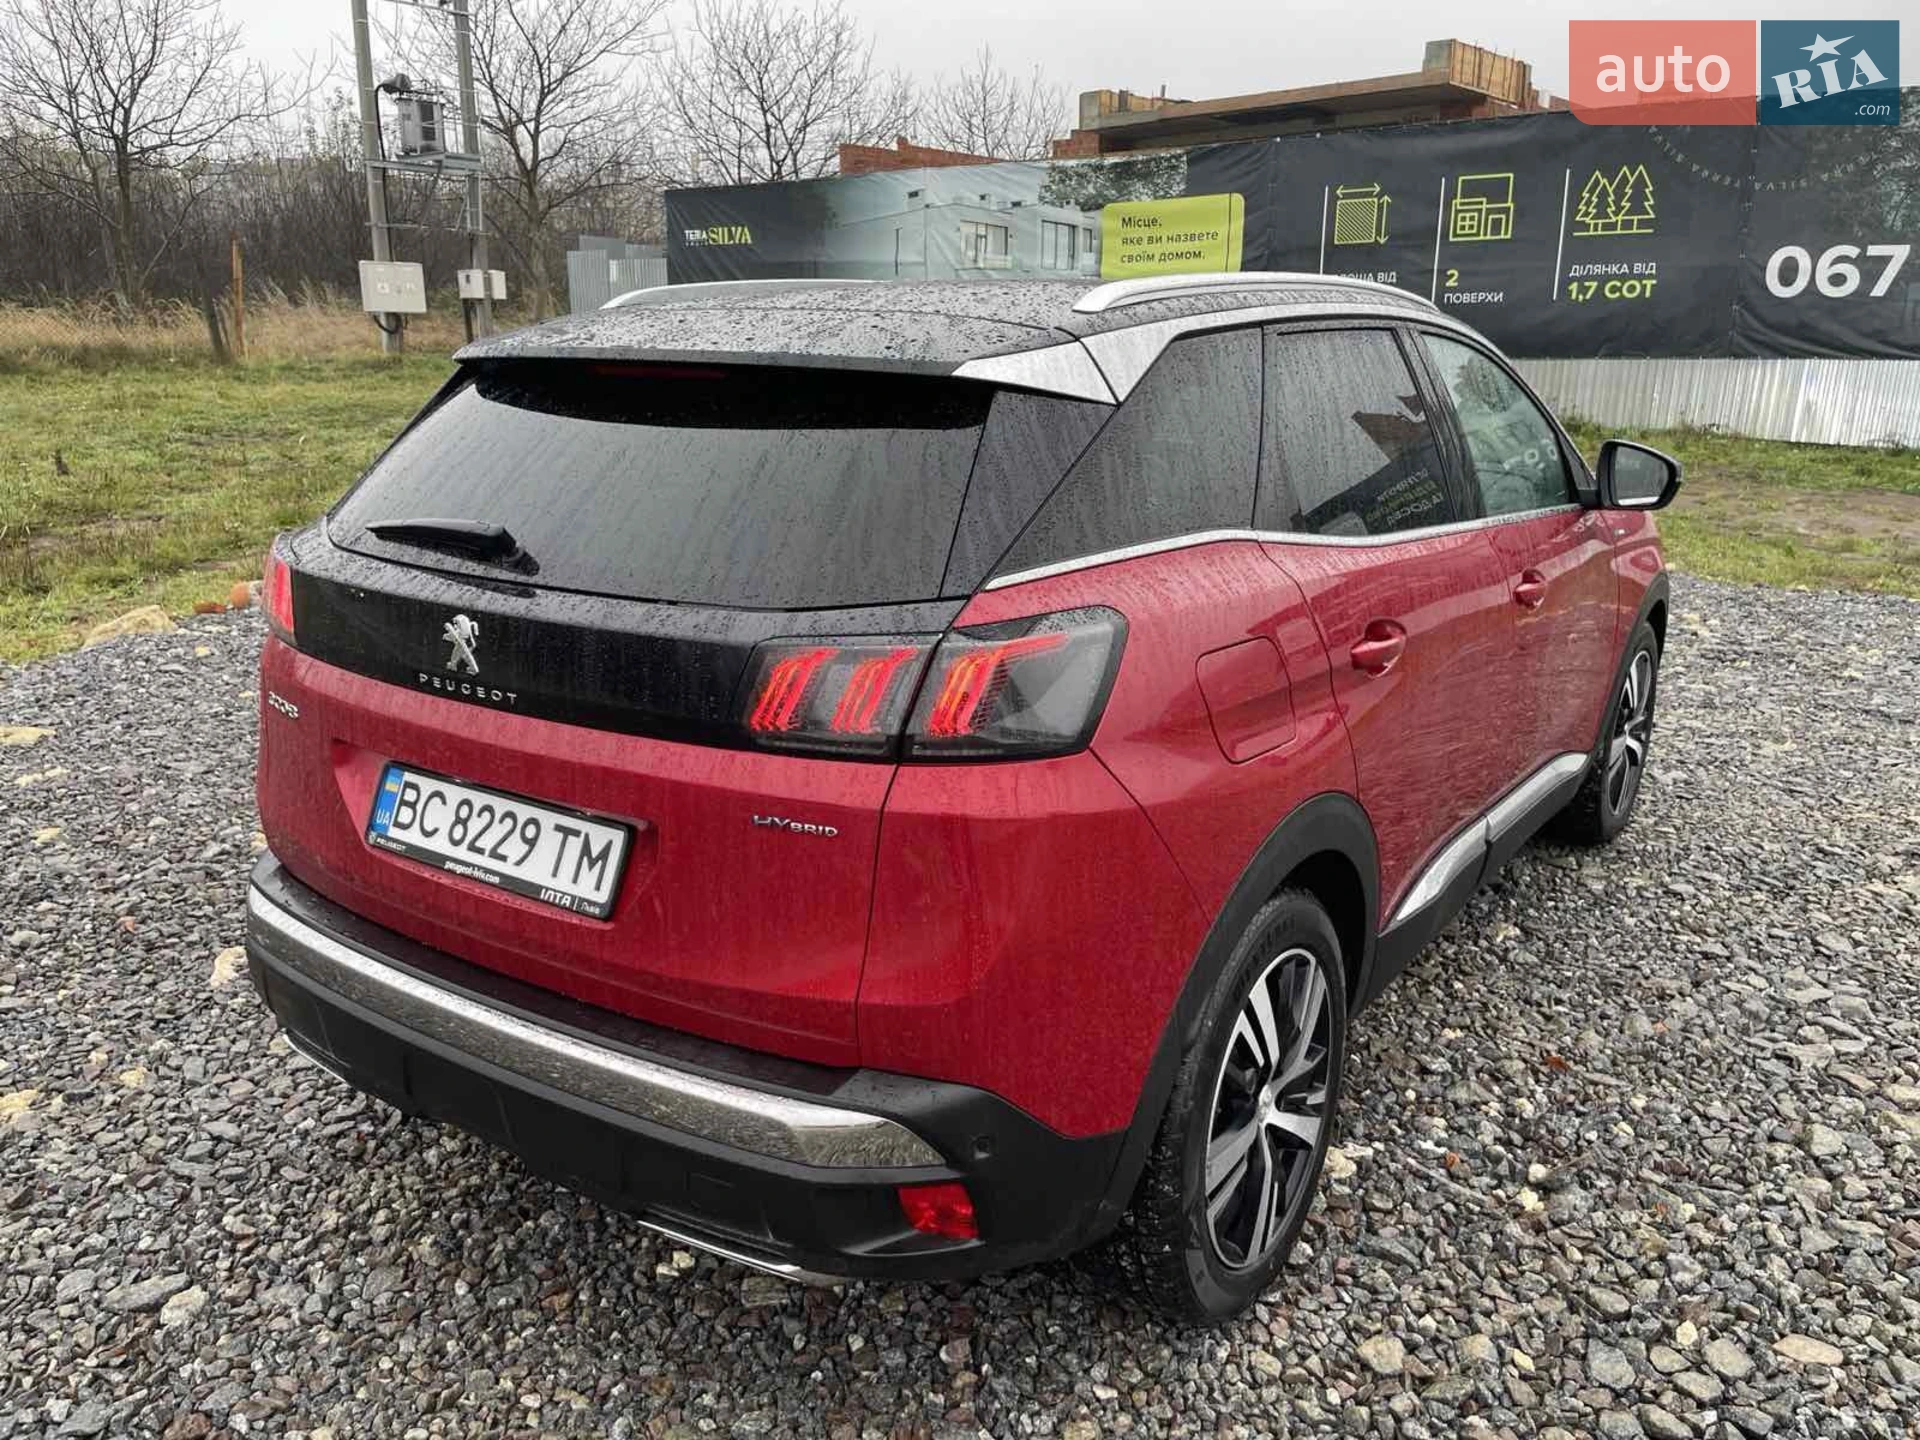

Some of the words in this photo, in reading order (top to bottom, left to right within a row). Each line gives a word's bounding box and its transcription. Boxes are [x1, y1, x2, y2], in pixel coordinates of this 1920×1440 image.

[1121, 216, 1162, 229] Місце,
[708, 226, 752, 245] SILVA
[1122, 235, 1143, 246] яке
[1147, 235, 1162, 245] ви
[1167, 230, 1219, 244] назвете
[1121, 251, 1155, 263] своїм
[1377, 271, 1397, 284] ВІД
[1445, 269, 1459, 287] 2
[1569, 263, 1629, 277] ДІЛЯНКА
[1633, 262, 1657, 275] ВІД
[1765, 244, 1911, 298] 067
[1444, 292, 1503, 304] ПОВЕРХИ
[1568, 281, 1598, 302] 1,7
[1604, 279, 1657, 298] СОТ
[419, 673, 517, 705] PEUGEOT
[377, 811, 390, 825] UA
[753, 815, 838, 837] HYBRID
[392, 781, 447, 838] BC
[448, 798, 542, 867] 8229
[551, 823, 614, 892] TM
